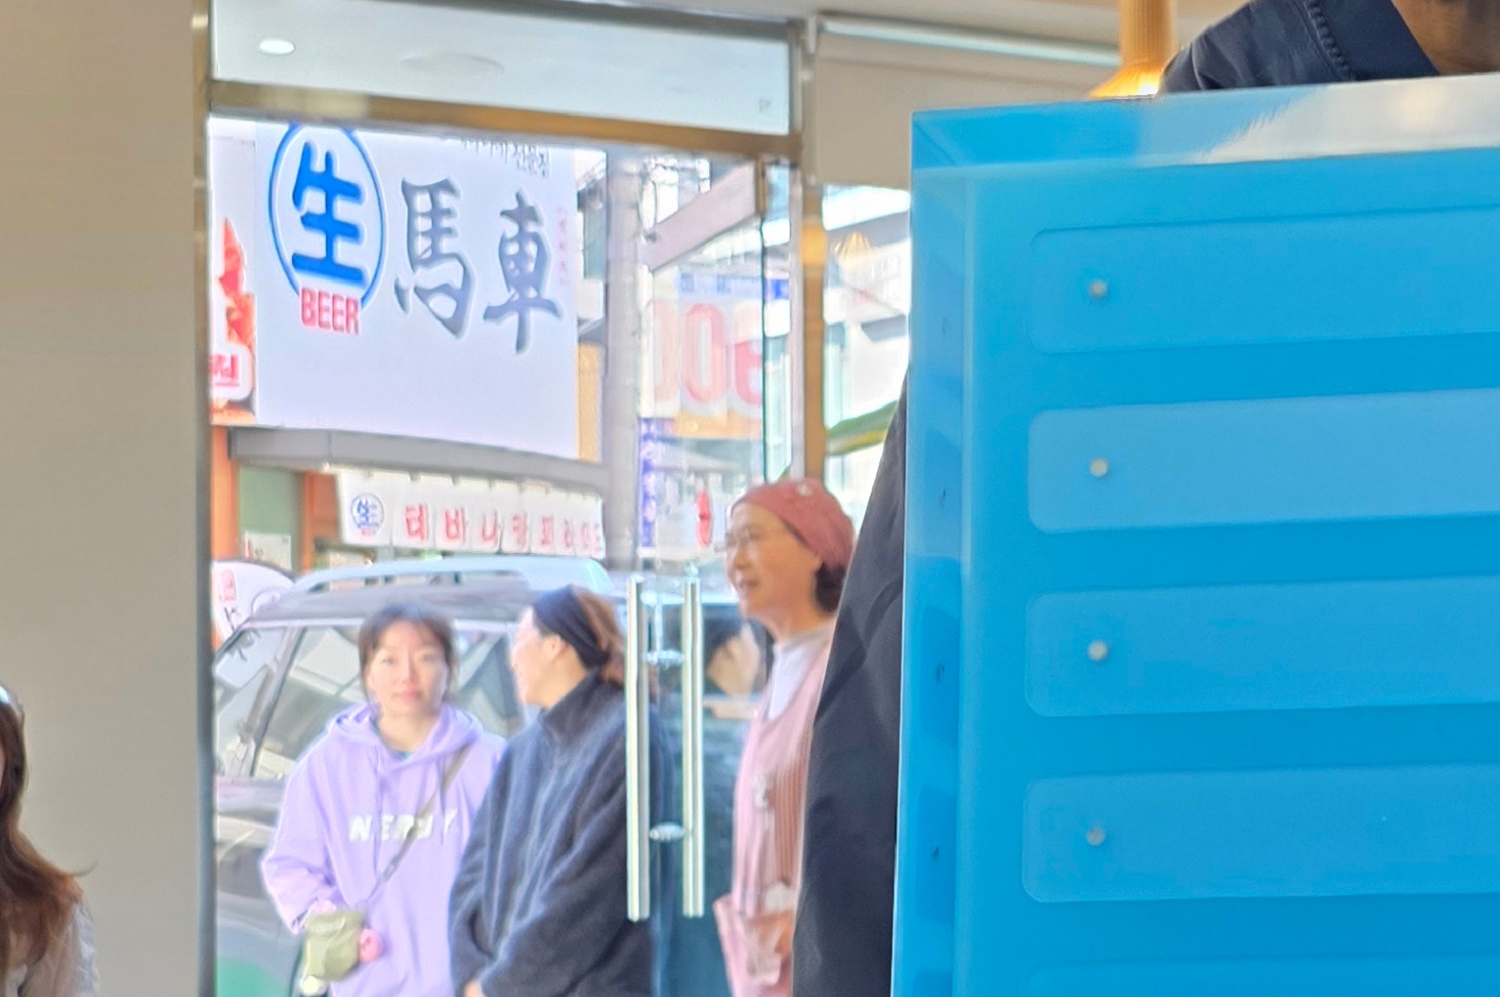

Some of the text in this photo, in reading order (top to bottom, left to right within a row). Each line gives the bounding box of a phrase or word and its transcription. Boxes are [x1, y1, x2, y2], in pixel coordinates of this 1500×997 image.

[291, 141, 369, 288] 生
[394, 176, 563, 355] 馬車
[300, 286, 361, 336] BEER
